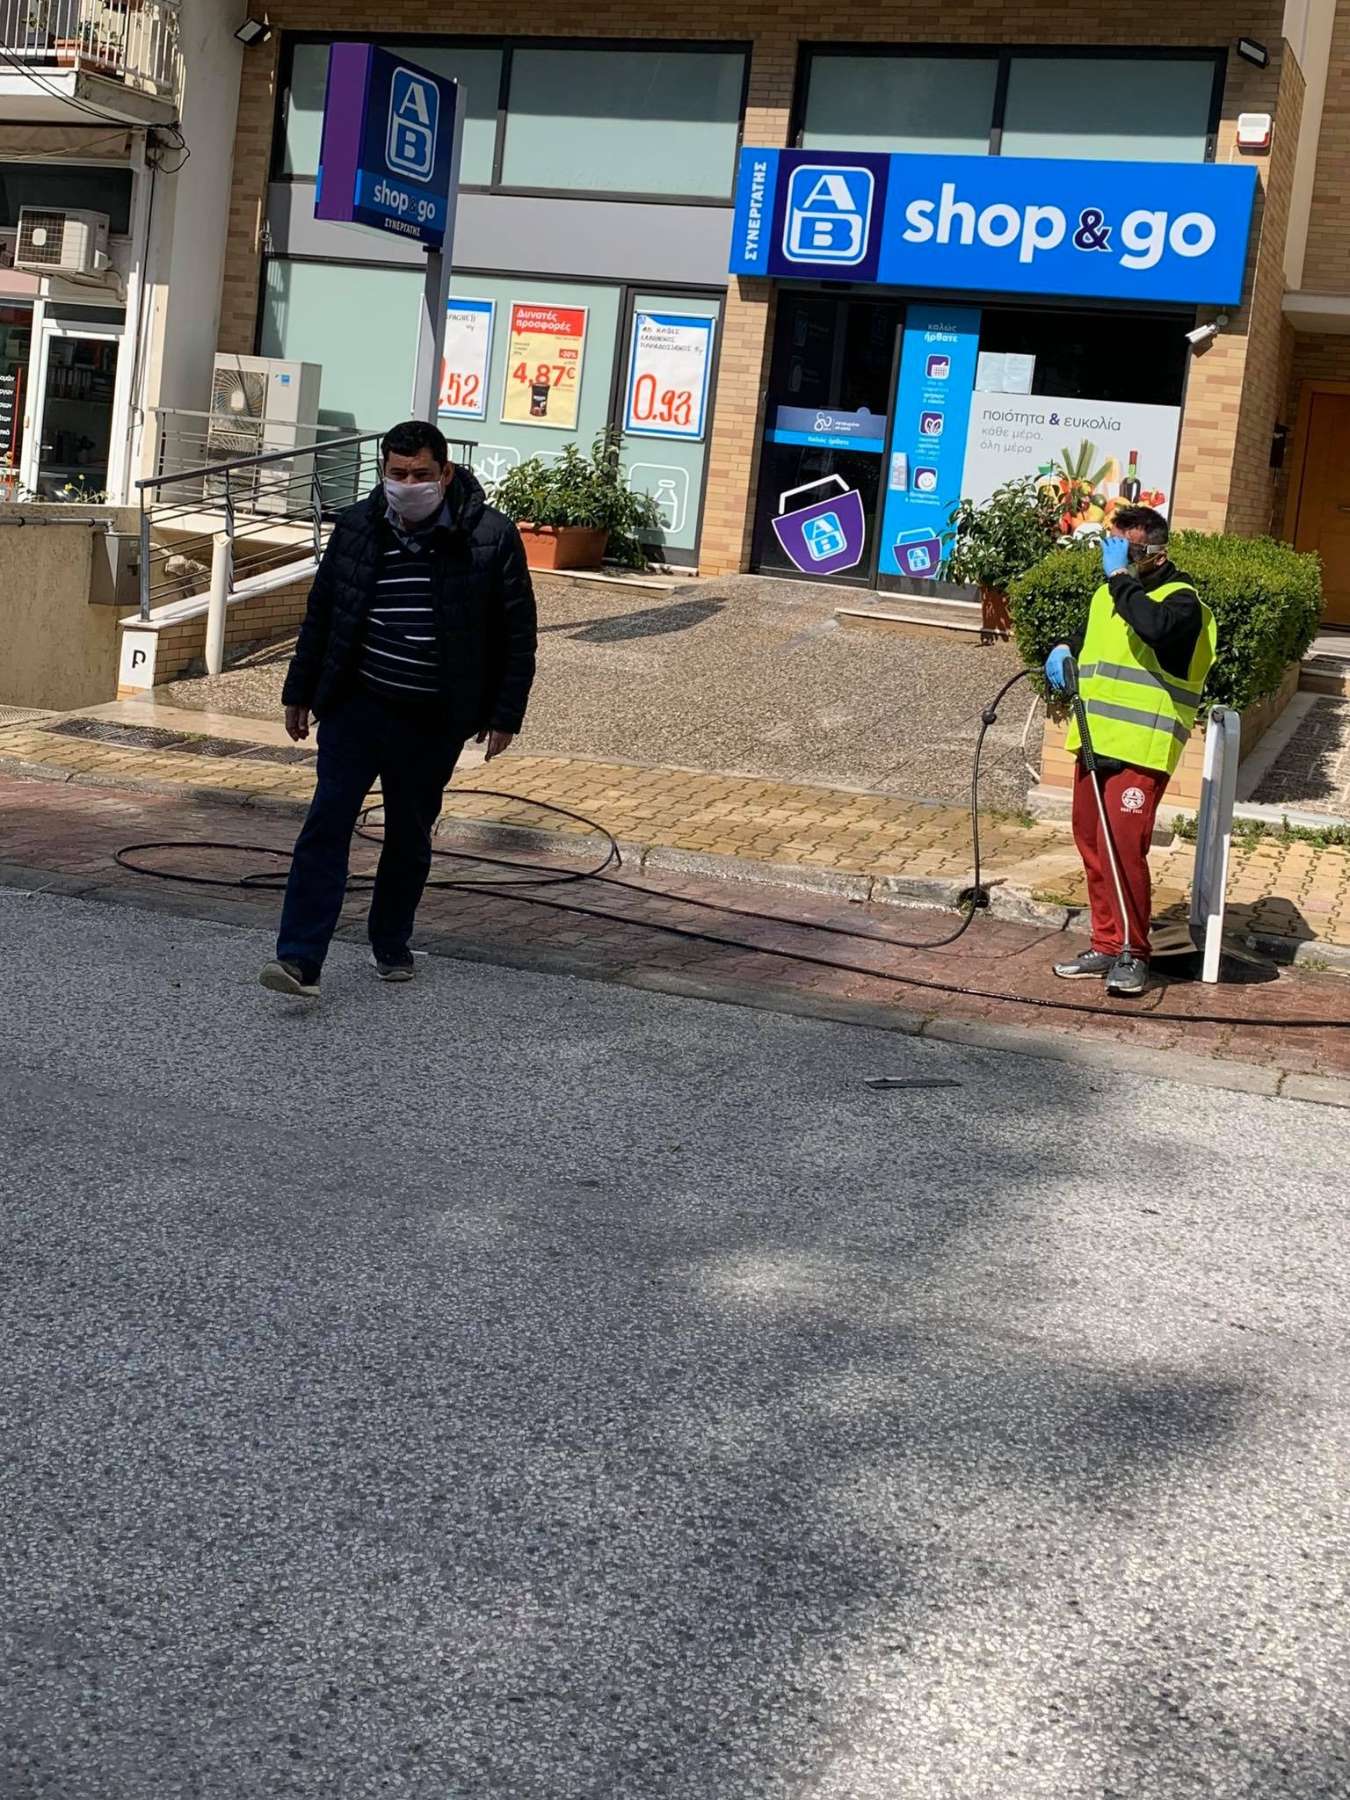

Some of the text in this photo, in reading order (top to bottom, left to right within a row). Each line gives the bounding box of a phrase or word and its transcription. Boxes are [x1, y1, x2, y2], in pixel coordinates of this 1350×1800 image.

[373, 179, 409, 215] shop
[417, 200, 436, 222] go
[744, 161, 767, 261] ΣΥΝΕΡΓΑΤΗΣ
[902, 182, 1217, 270] shop & go
[516, 309, 559, 322] Δυνατές
[515, 319, 572, 333] προσφορές
[927, 323, 958, 333] καλώς
[924, 331, 959, 343] ήρθατε
[982, 409, 1122, 431] ποιότητα & ευκολία
[981, 426, 1009, 437] κάθε
[980, 440, 1033, 454] όλη μέρα
[131, 649, 147, 669] P
